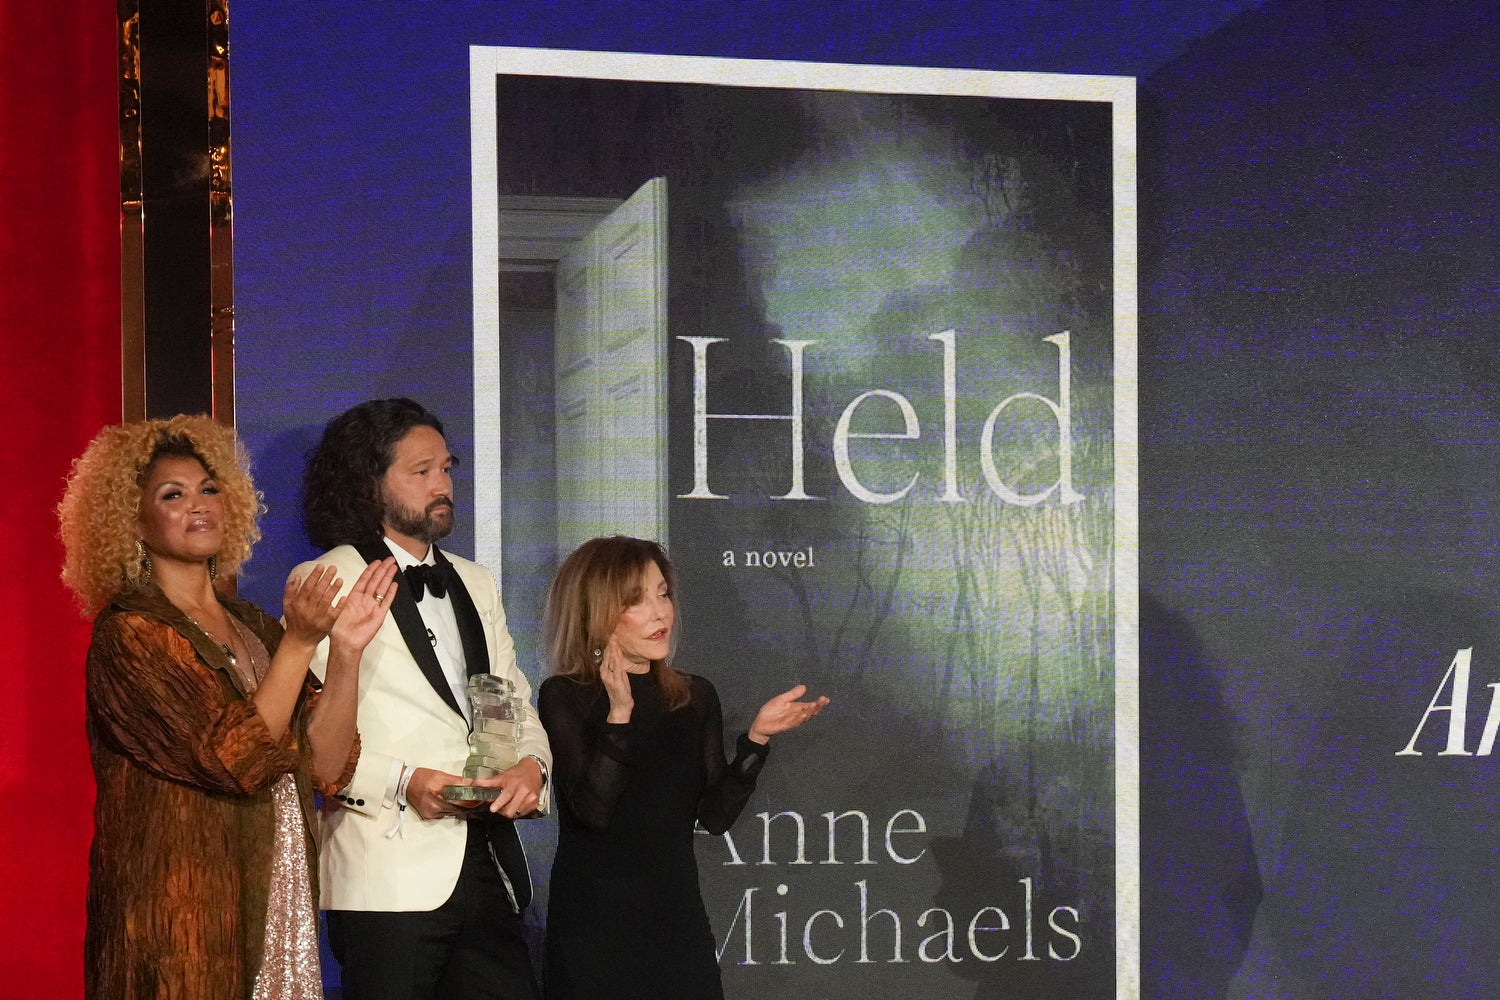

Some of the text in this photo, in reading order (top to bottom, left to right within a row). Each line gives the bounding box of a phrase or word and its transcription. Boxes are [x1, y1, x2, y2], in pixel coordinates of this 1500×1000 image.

[676, 330, 1086, 505] Held
[722, 545, 816, 568] a novel
